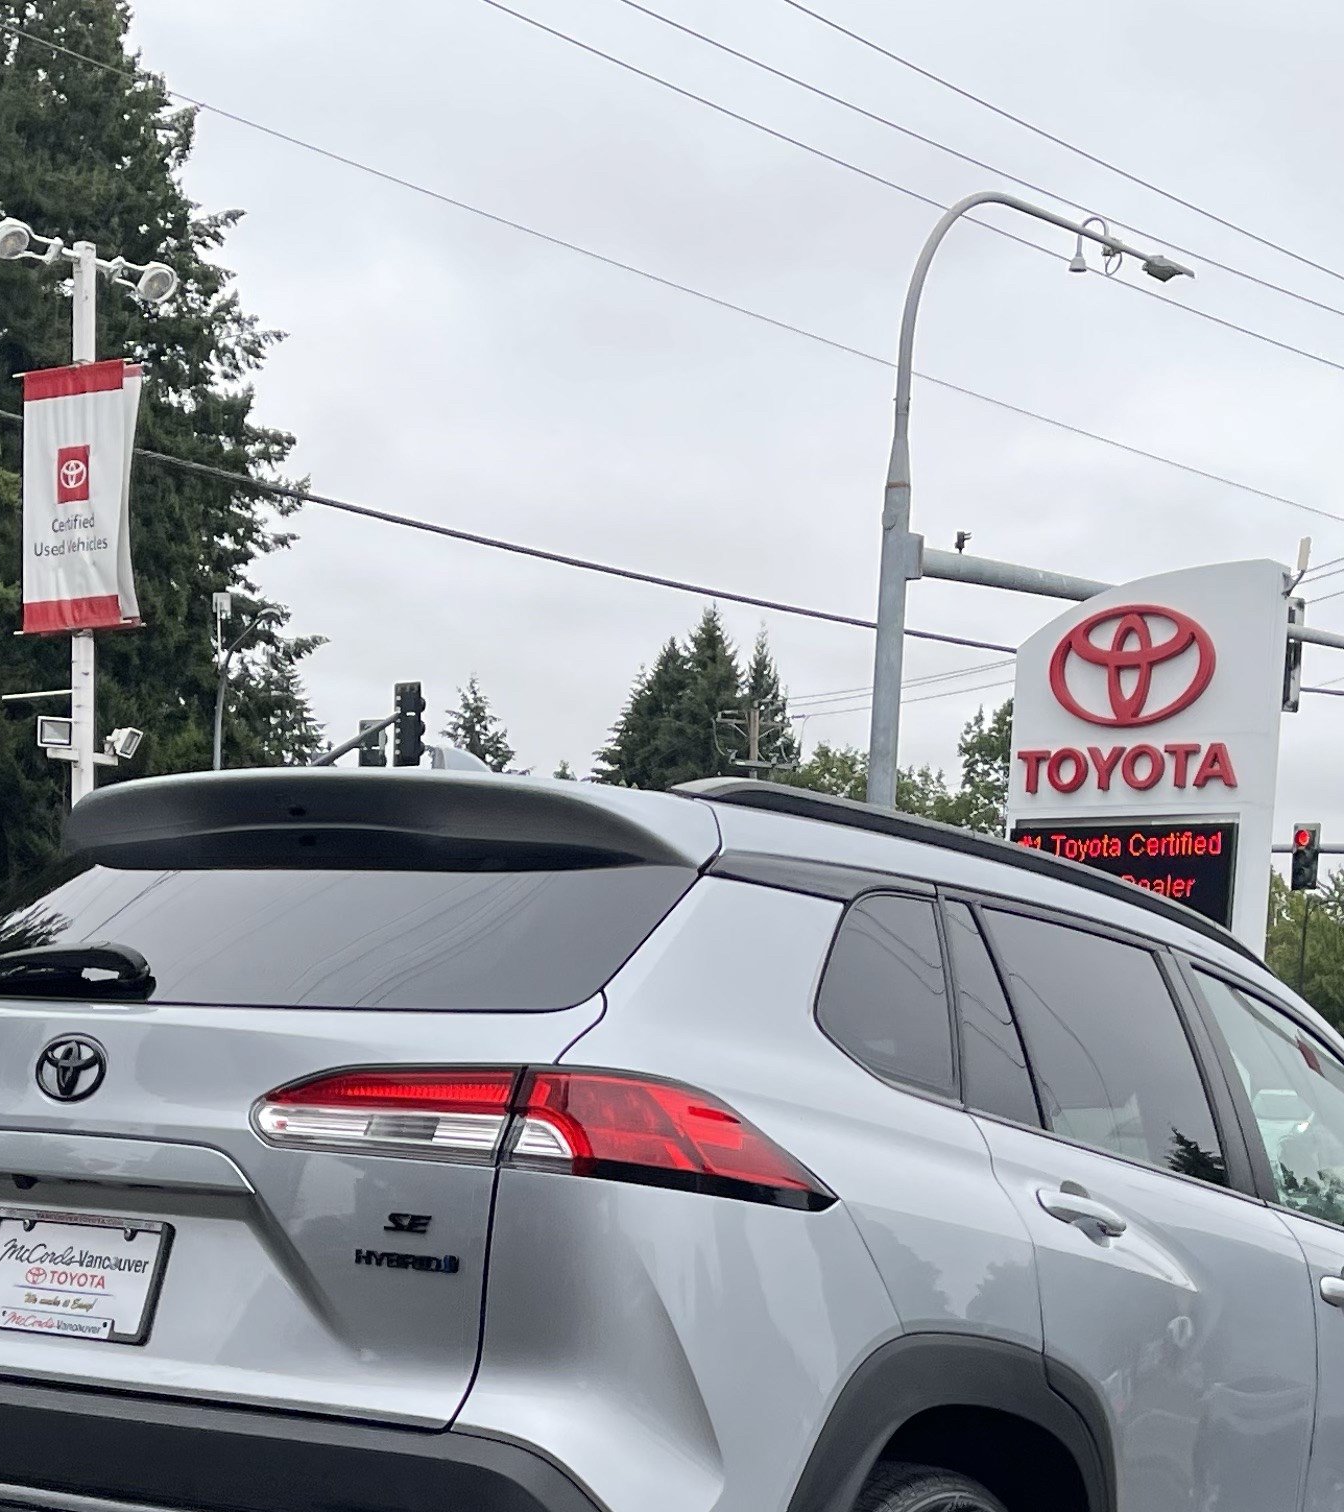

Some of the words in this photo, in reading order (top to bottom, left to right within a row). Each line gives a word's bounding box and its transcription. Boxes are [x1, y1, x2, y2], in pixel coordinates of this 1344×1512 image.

[52, 513, 95, 533] Certified
[34, 540, 65, 557] Used
[66, 536, 108, 554] Vehicles
[1017, 742, 1238, 794] TOYOTA
[1051, 834, 1121, 861] Toyota
[1129, 832, 1222, 857] Certified
[383, 1213, 432, 1234] SE
[49, 1270, 106, 1289] TOYOTA
